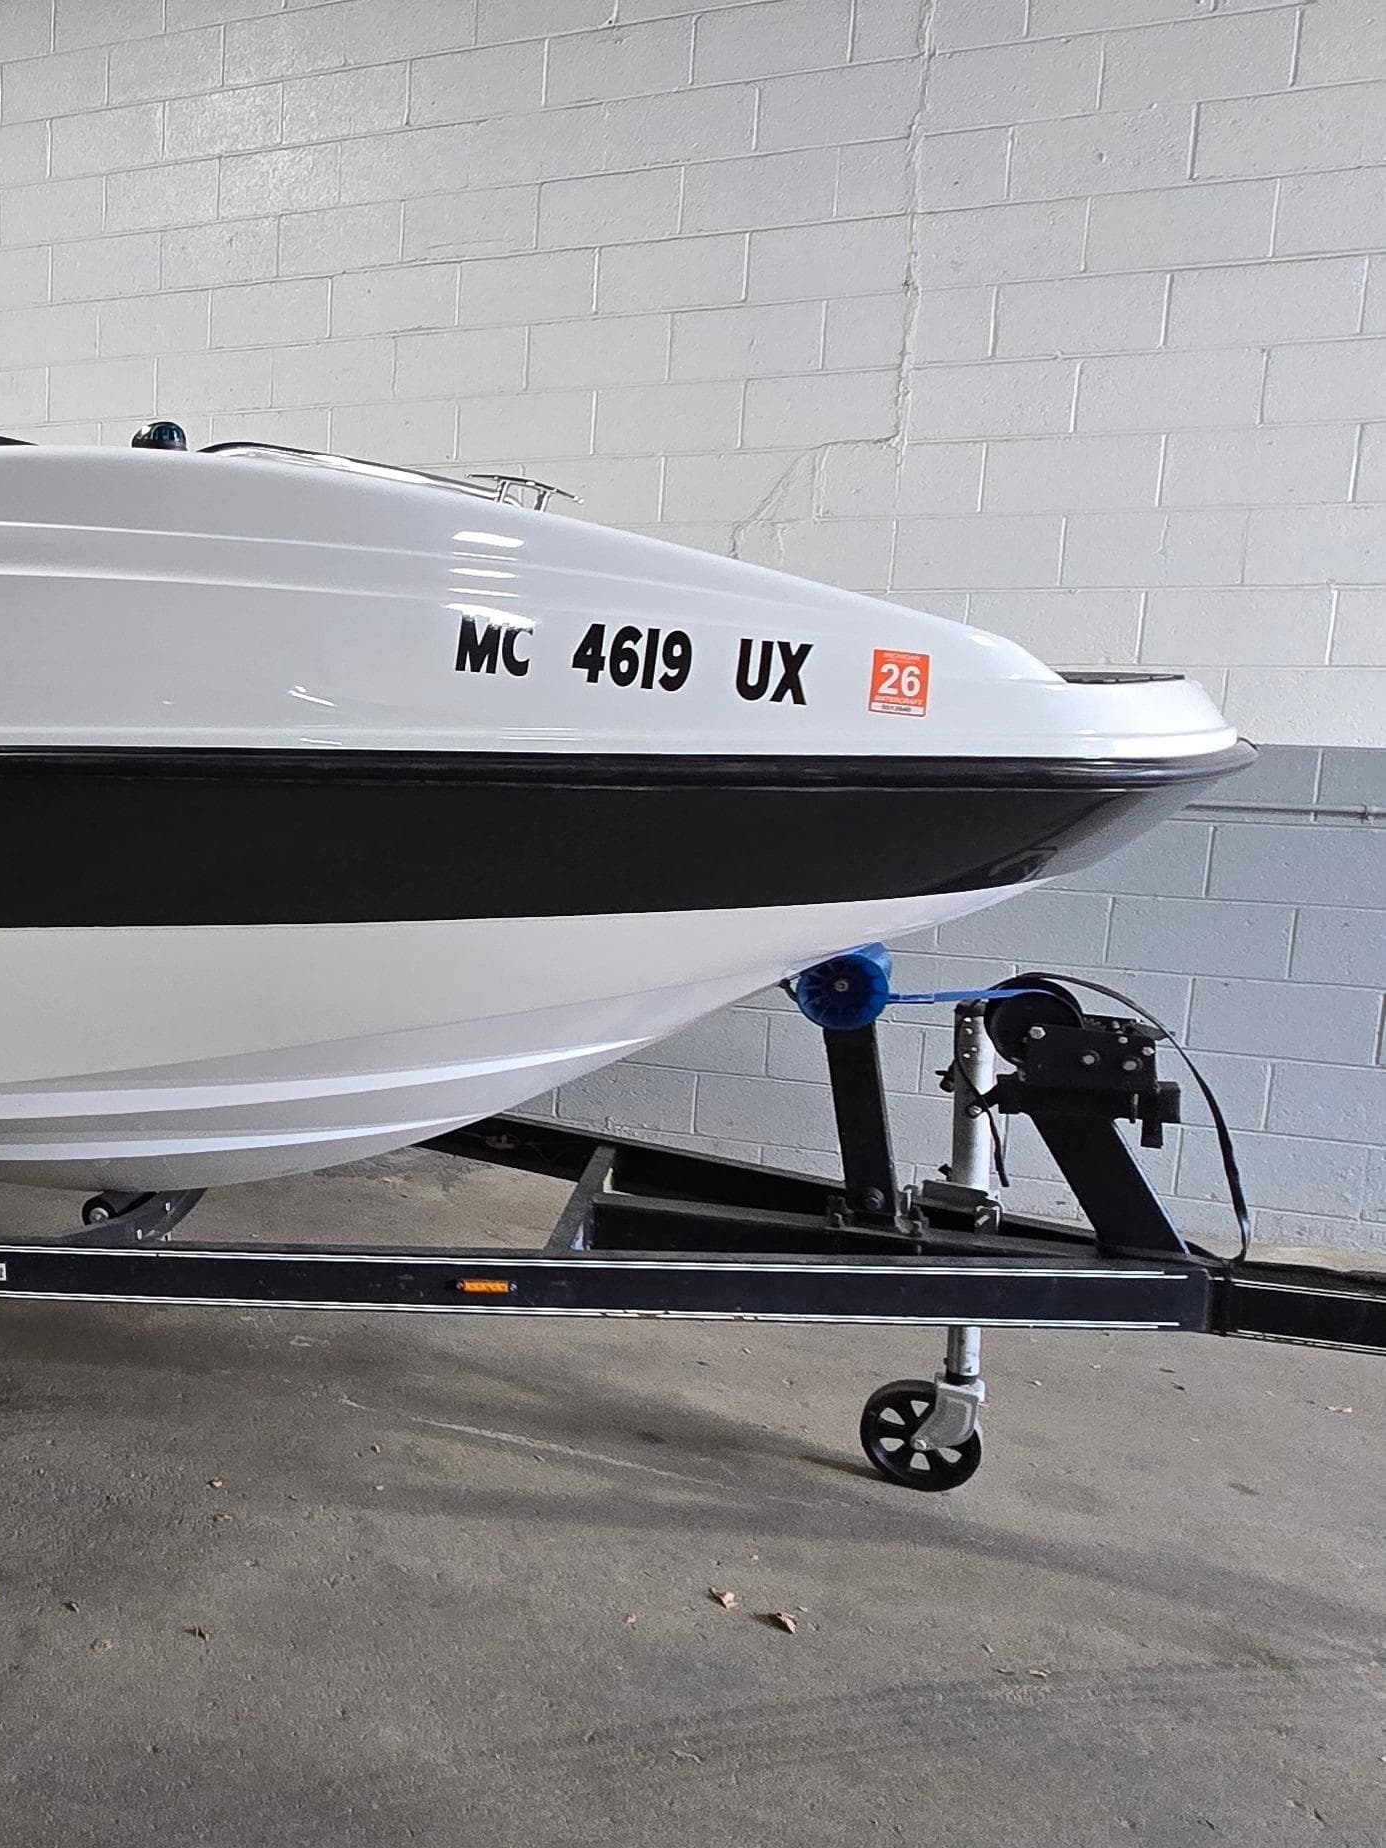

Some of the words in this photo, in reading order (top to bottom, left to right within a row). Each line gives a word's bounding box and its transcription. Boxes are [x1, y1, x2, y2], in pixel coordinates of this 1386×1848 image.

[455, 615, 533, 677] MC
[572, 623, 693, 692] 4619
[736, 638, 814, 705] UX
[877, 662, 921, 697] 26
